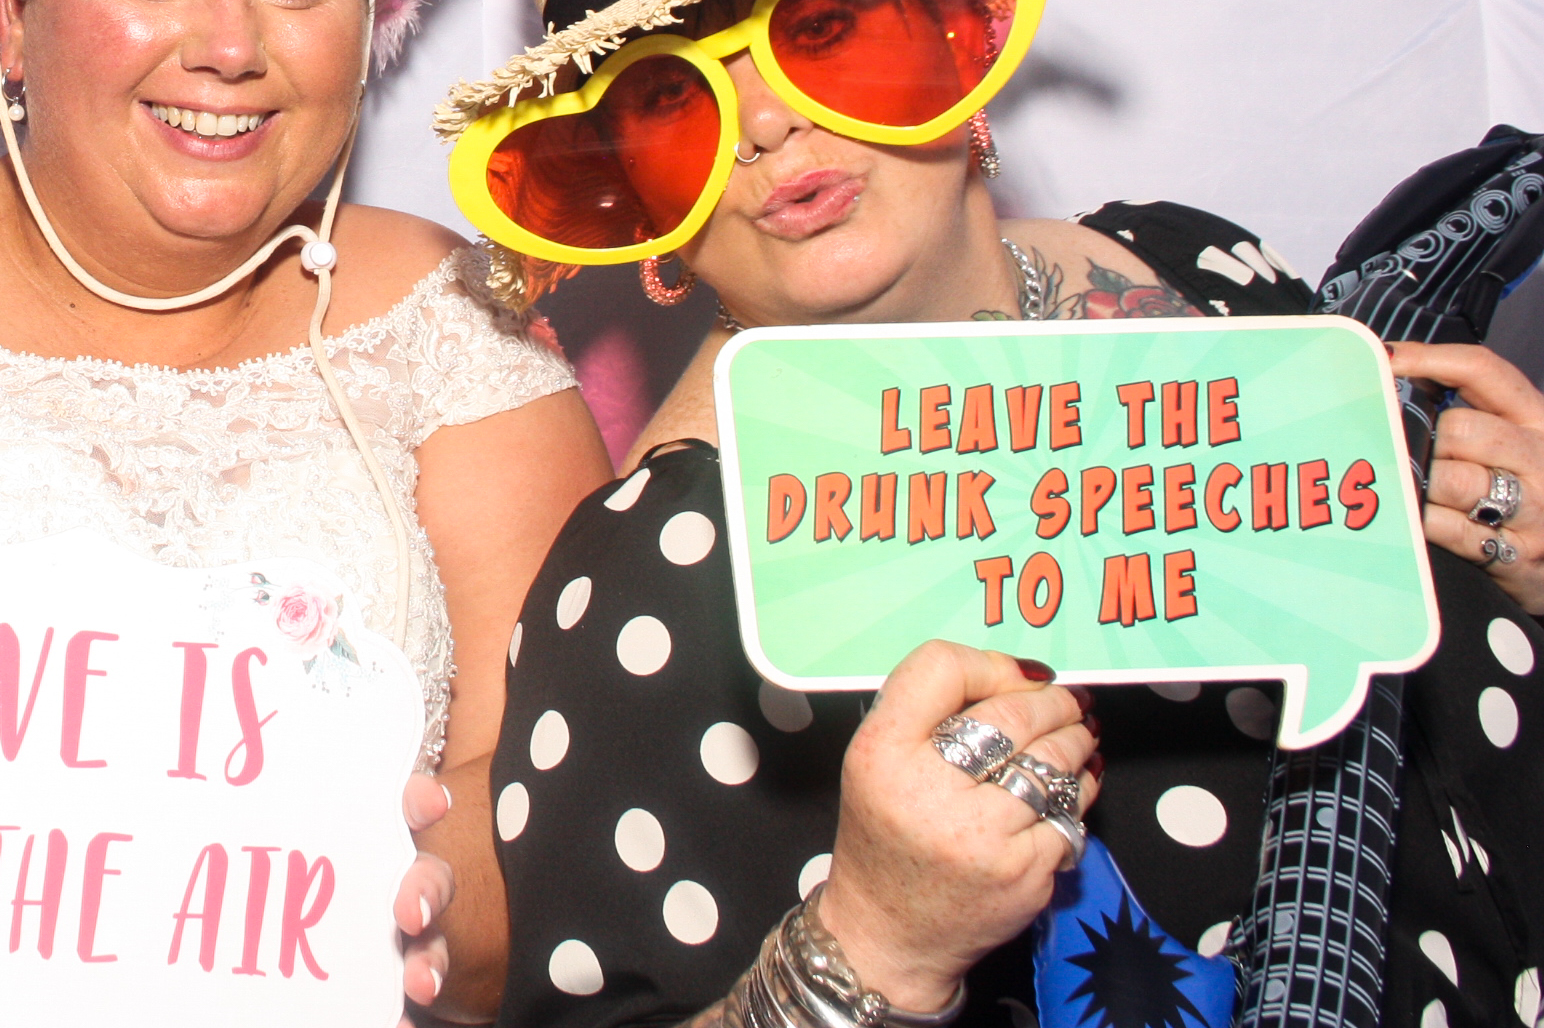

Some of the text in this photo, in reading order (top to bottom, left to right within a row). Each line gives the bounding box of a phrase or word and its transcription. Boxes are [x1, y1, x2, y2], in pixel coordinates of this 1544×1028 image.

[880, 377, 1241, 454] LEAVE THE
[766, 459, 1379, 544] DRUNK SPEECHES
[974, 549, 1198, 628] TO ME
[166, 641, 278, 786] IS
[167, 842, 336, 981] AIR
